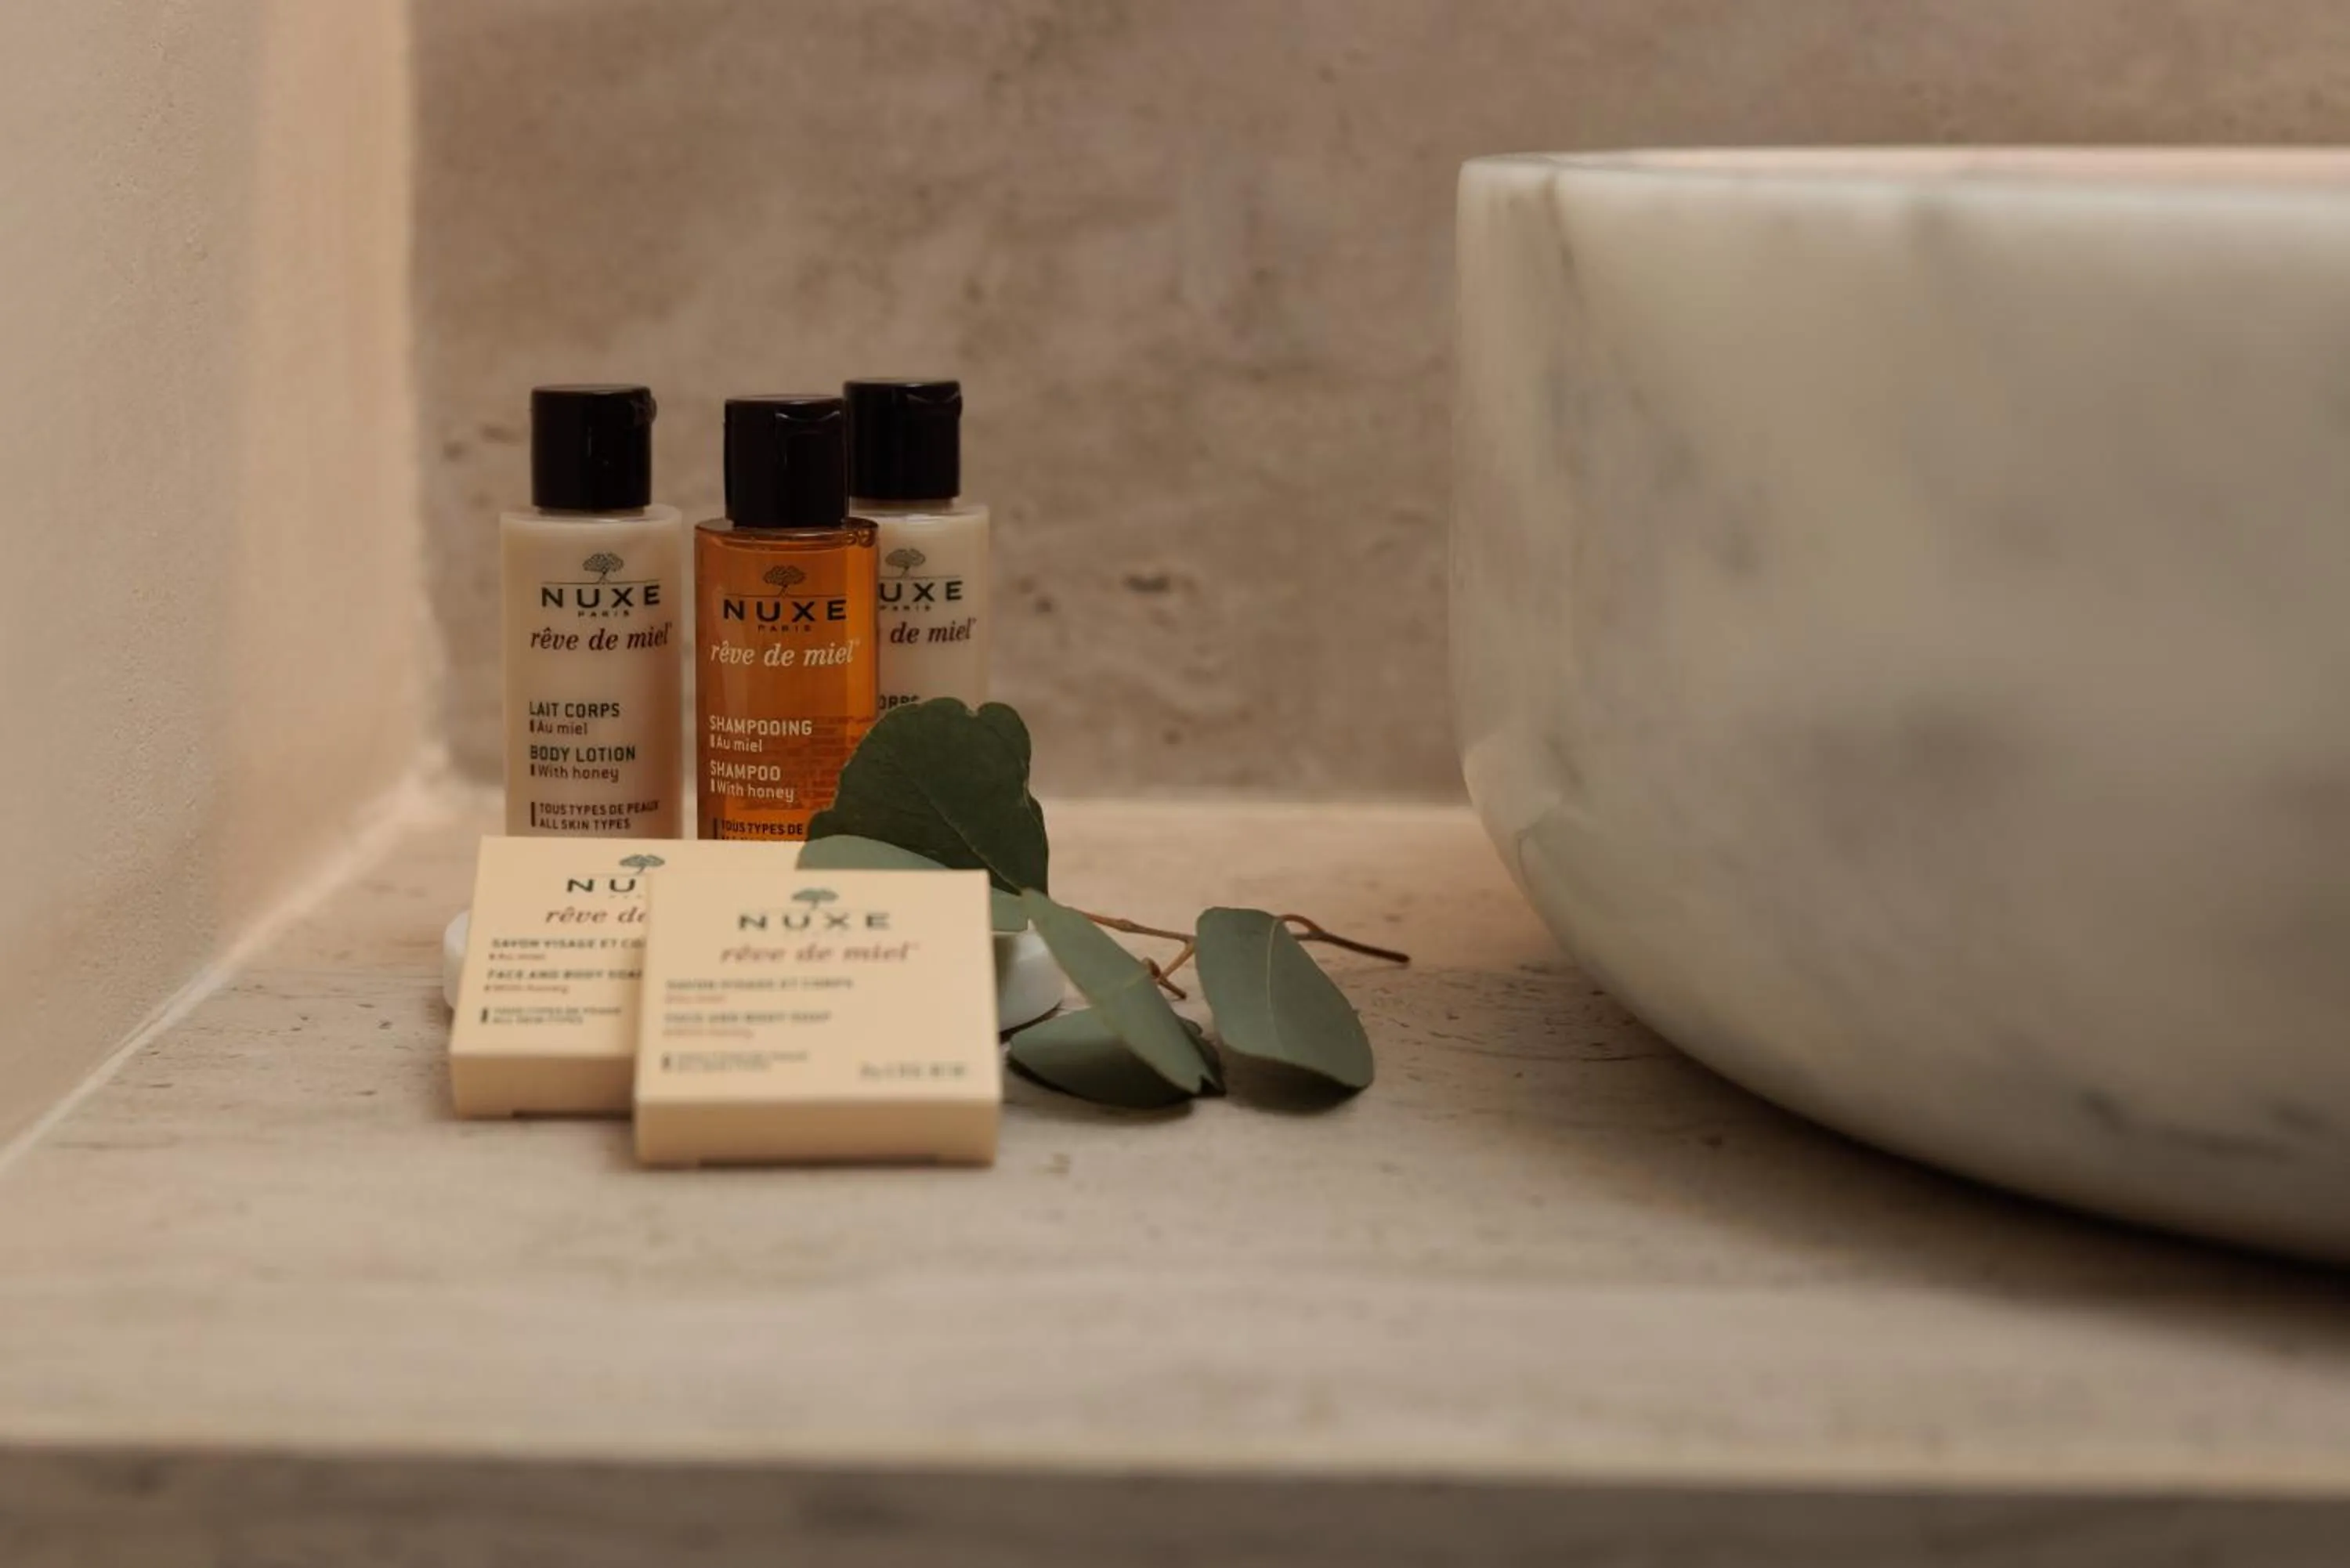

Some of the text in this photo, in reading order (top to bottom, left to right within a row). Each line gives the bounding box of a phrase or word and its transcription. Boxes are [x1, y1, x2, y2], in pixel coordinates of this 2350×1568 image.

[540, 585, 660, 608] NUXE
[879, 580, 964, 602] UXE
[723, 599, 847, 623] NUXE
[530, 627, 579, 651] rêve
[588, 628, 619, 651] de
[757, 625, 812, 634] PARIS
[890, 621, 920, 644] de
[710, 640, 755, 665] rêve
[764, 643, 795, 667] de
[529, 702, 620, 718] LAIT CORPS
[537, 720, 588, 735] Au miel
[709, 715, 813, 736] SHAMPOOING
[530, 745, 636, 762] BODY LOTION
[715, 735, 762, 753] Au miel
[537, 764, 620, 782] With honey
[710, 759, 781, 782] SHAMPOO
[716, 780, 794, 803] With honey
[539, 800, 660, 816] TOUS TYPES DE PEAUX
[539, 818, 631, 831] ALL SKIN TYPES
[721, 819, 804, 836] TOUS TYPES DE
[566, 878, 637, 894] NU
[545, 906, 609, 924] rêve
[737, 912, 891, 932] NUXE
[720, 942, 786, 964] rêve
[796, 941, 832, 963] de
